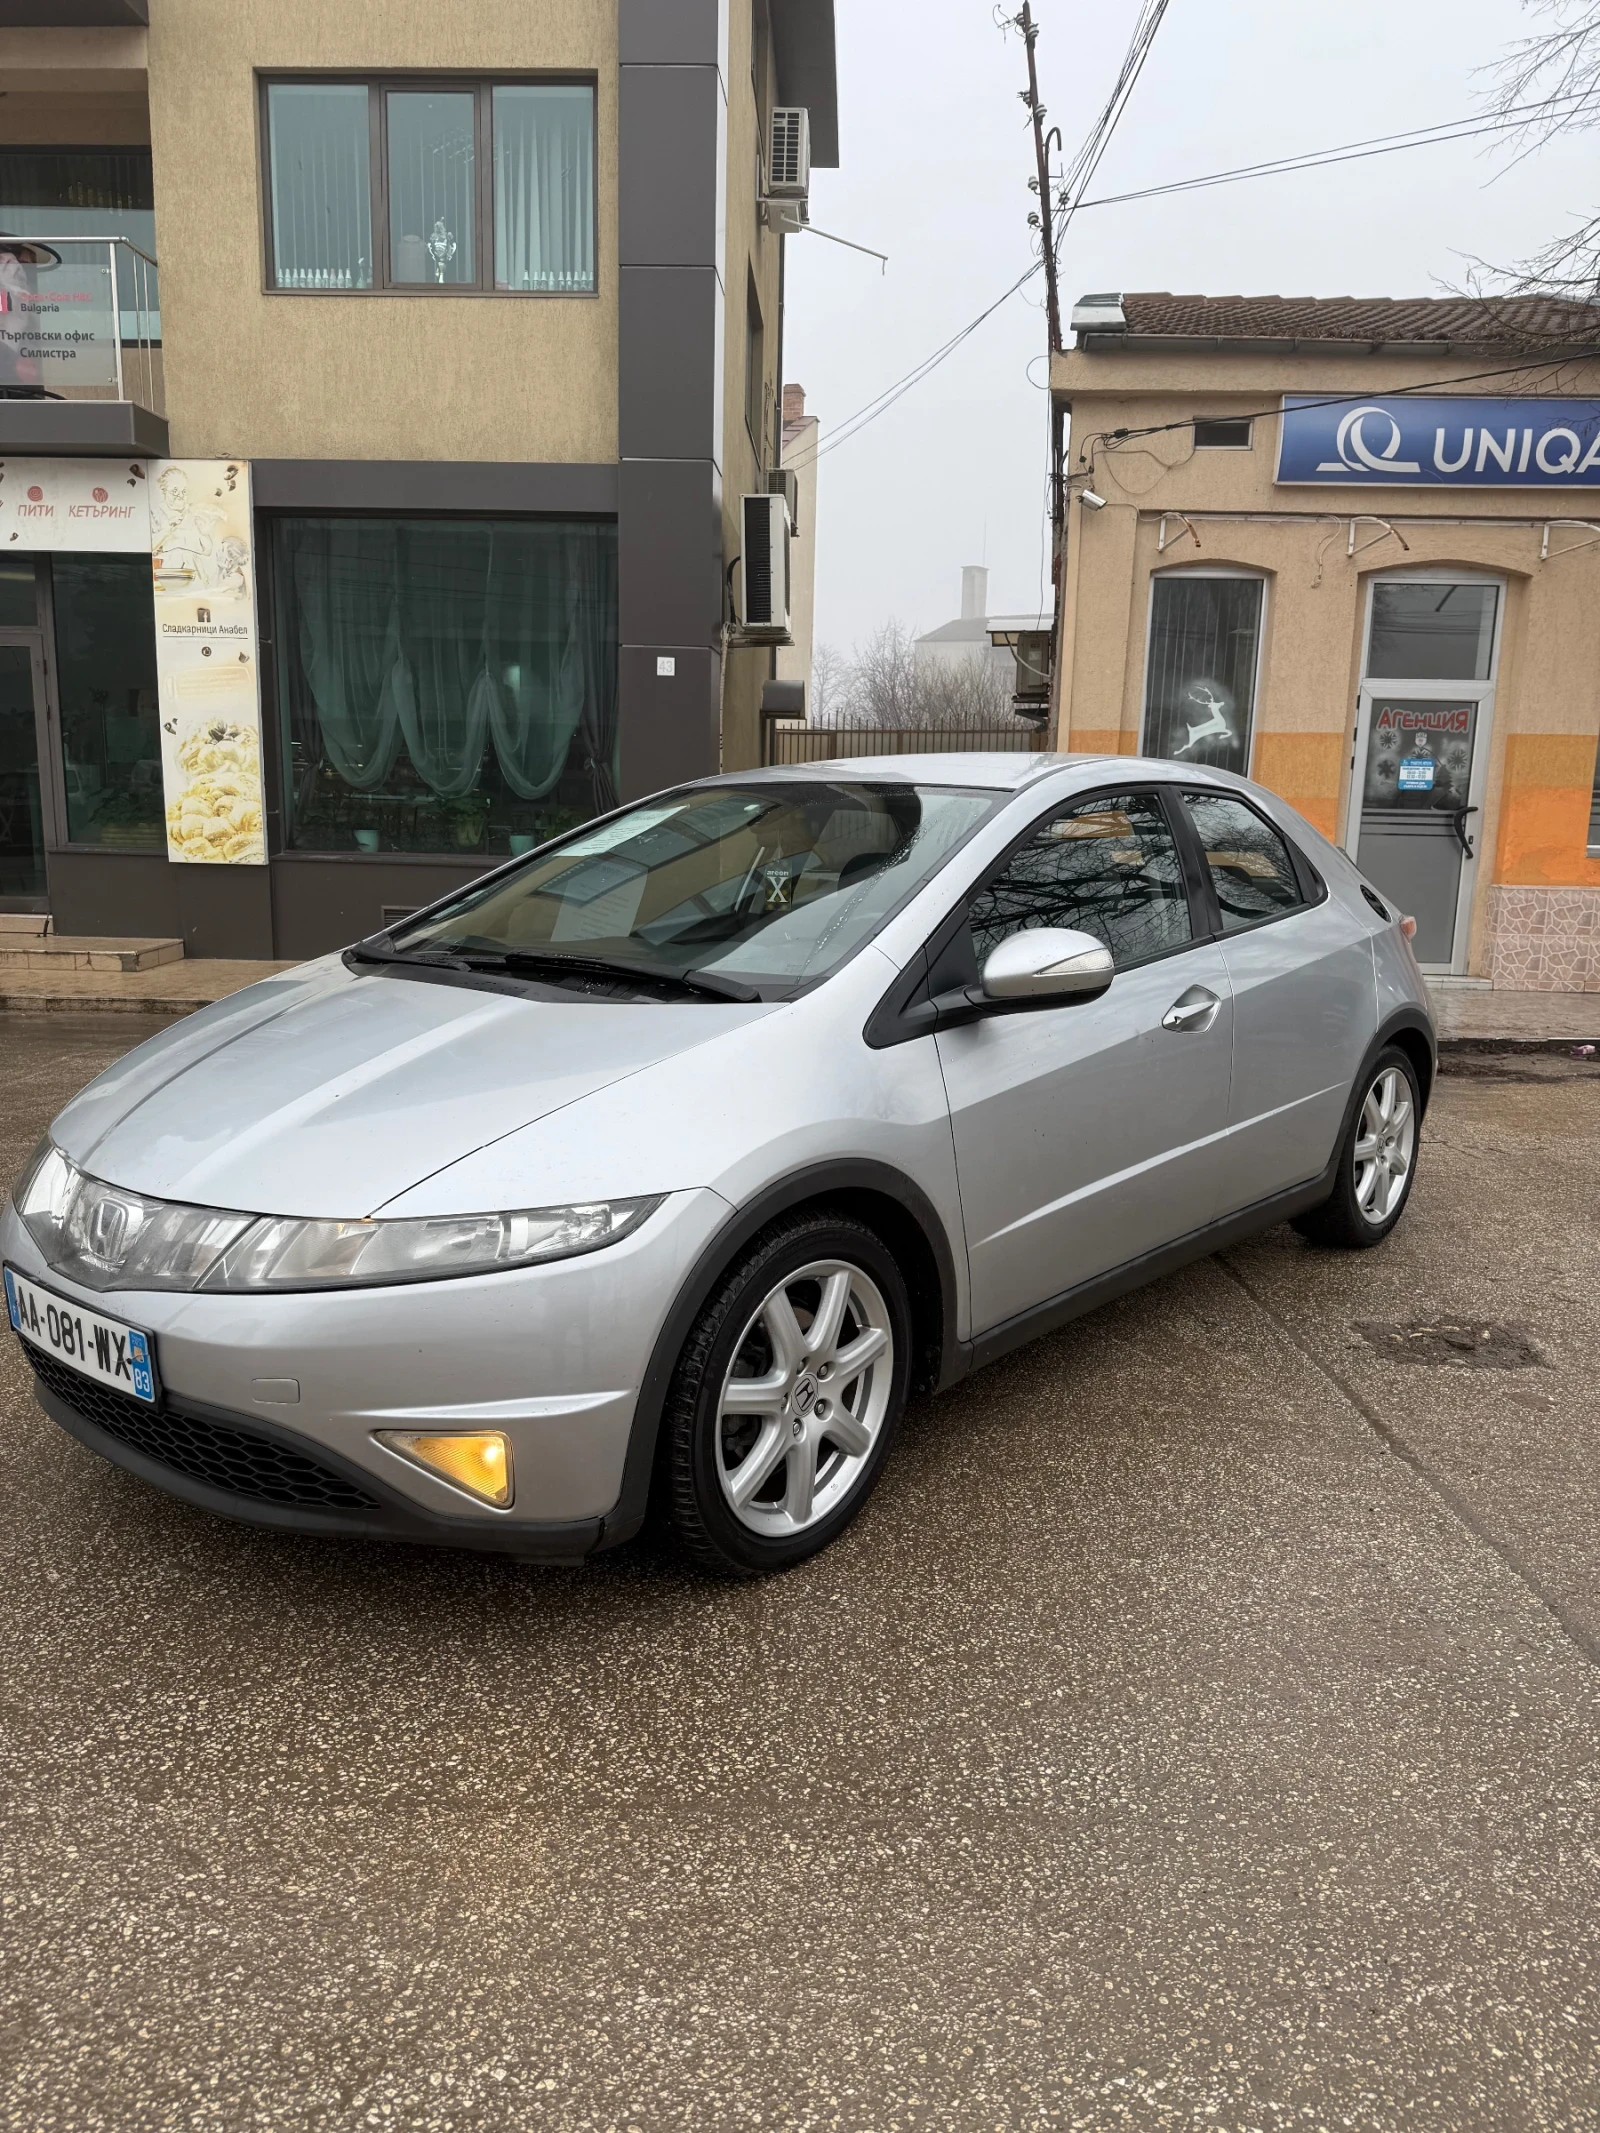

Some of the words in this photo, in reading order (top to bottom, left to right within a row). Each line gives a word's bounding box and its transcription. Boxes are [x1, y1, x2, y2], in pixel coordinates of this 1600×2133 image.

[20, 303, 60, 314] Bulgaria
[0, 329, 62, 343] Търговски
[64, 329, 95, 343] офис
[20, 347, 77, 361] Силистра
[17, 504, 55, 517] ПИТИ
[68, 505, 136, 519] КЕТЪРИНГ
[162, 623, 218, 635] Сладкарници
[218, 625, 248, 635] Анабел
[659, 660, 673, 673] 43
[1377, 707, 1470, 733] АГЕНЦИЯ
[767, 876, 789, 903] X
[18, 1285, 132, 1382] AA-081-WX
[134, 1367, 150, 1393] 83
